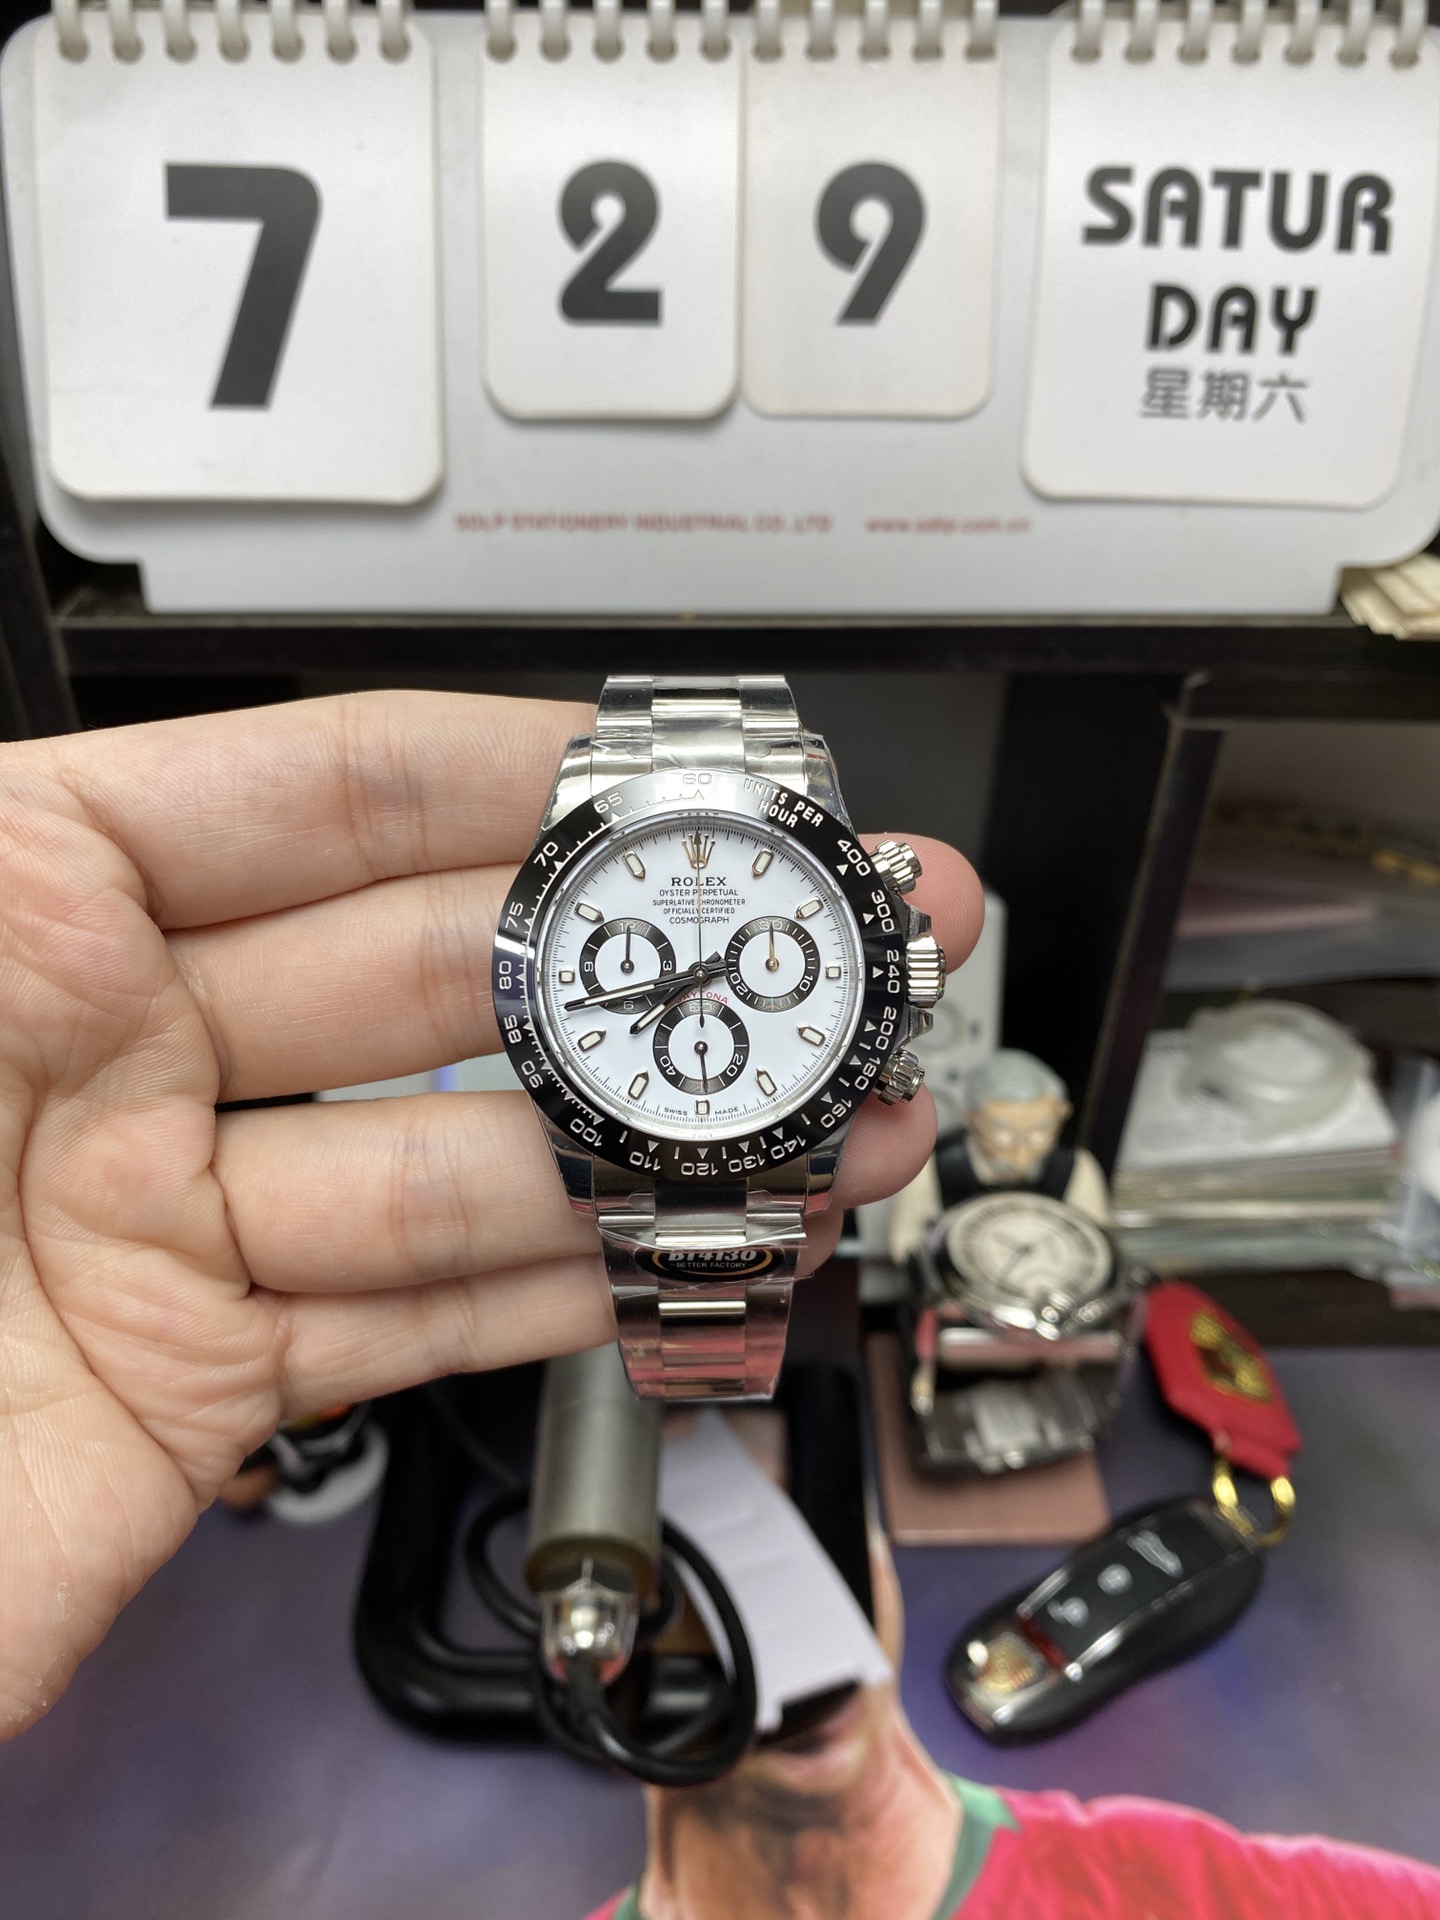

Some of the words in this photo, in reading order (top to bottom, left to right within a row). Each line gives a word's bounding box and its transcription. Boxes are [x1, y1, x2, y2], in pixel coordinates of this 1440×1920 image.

[1081, 165, 1395, 255] SATUR
[559, 159, 663, 327] 2
[814, 160, 927, 327] 9
[164, 162, 322, 411] 7
[1147, 282, 1317, 356] DAY
[1140, 365, 1309, 423] 星期六
[682, 773, 712, 785] 60
[594, 792, 623, 814] 65
[743, 778, 788, 805] UNITS
[794, 800, 824, 827] PER
[759, 799, 799, 828] HOUR
[533, 841, 559, 867] 70
[837, 839, 871, 876] 400
[659, 889, 690, 897] OYSTER
[692, 888, 738, 896] PERPETUAL
[671, 877, 727, 887] ROLEX
[505, 901, 524, 928] 75
[663, 907, 699, 915] OFFICIALLY
[669, 916, 729, 925] COSMOGRAPH
[871, 889, 895, 933] 300
[498, 960, 513, 990] 80
[662, 960, 673, 971] 3
[886, 949, 900, 994] 240
[730, 972, 749, 995] 20
[799, 975, 814, 992] 10
[623, 1000, 635, 1010] 6
[503, 1014, 522, 1044] 85
[875, 1005, 897, 1051] 200
[521, 1060, 544, 1088] 90
[659, 1055, 676, 1076] 40
[726, 1053, 744, 1077] 20
[854, 1057, 881, 1091] 180
[664, 1107, 688, 1116] SWISS
[714, 1106, 739, 1115] MADE
[820, 1098, 852, 1129] 160
[569, 1118, 603, 1147] 100
[629, 1150, 661, 1171] 110
[770, 1134, 807, 1160] 140
[681, 1162, 719, 1176] 120
[728, 1153, 766, 1173] 130
